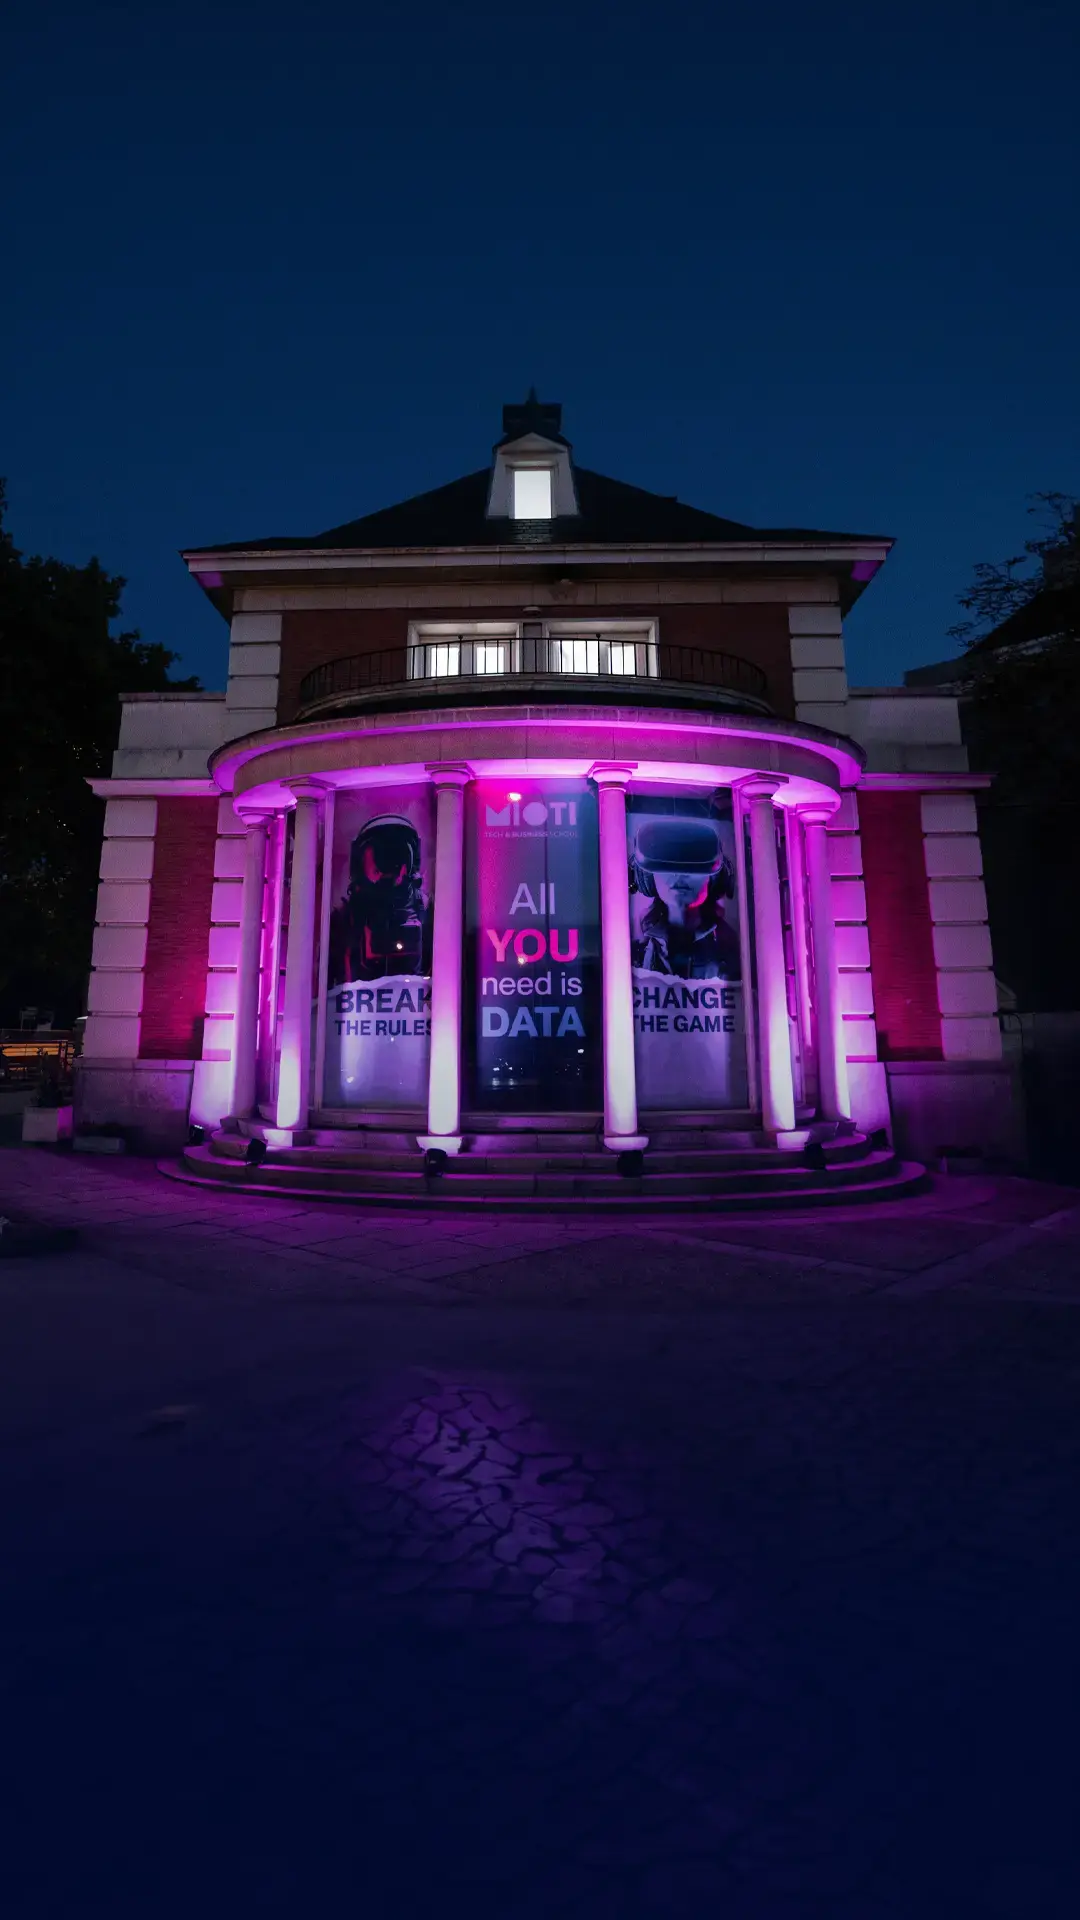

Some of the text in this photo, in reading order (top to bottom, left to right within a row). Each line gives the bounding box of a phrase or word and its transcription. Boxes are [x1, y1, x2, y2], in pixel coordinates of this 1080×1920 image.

[486, 801, 577, 826] MIOTI
[509, 883, 556, 915] All
[487, 929, 578, 963] YOU
[482, 971, 583, 995] need is
[334, 1020, 371, 1036] THE
[482, 1006, 586, 1037] DATA
[673, 1015, 735, 1032] GAME
